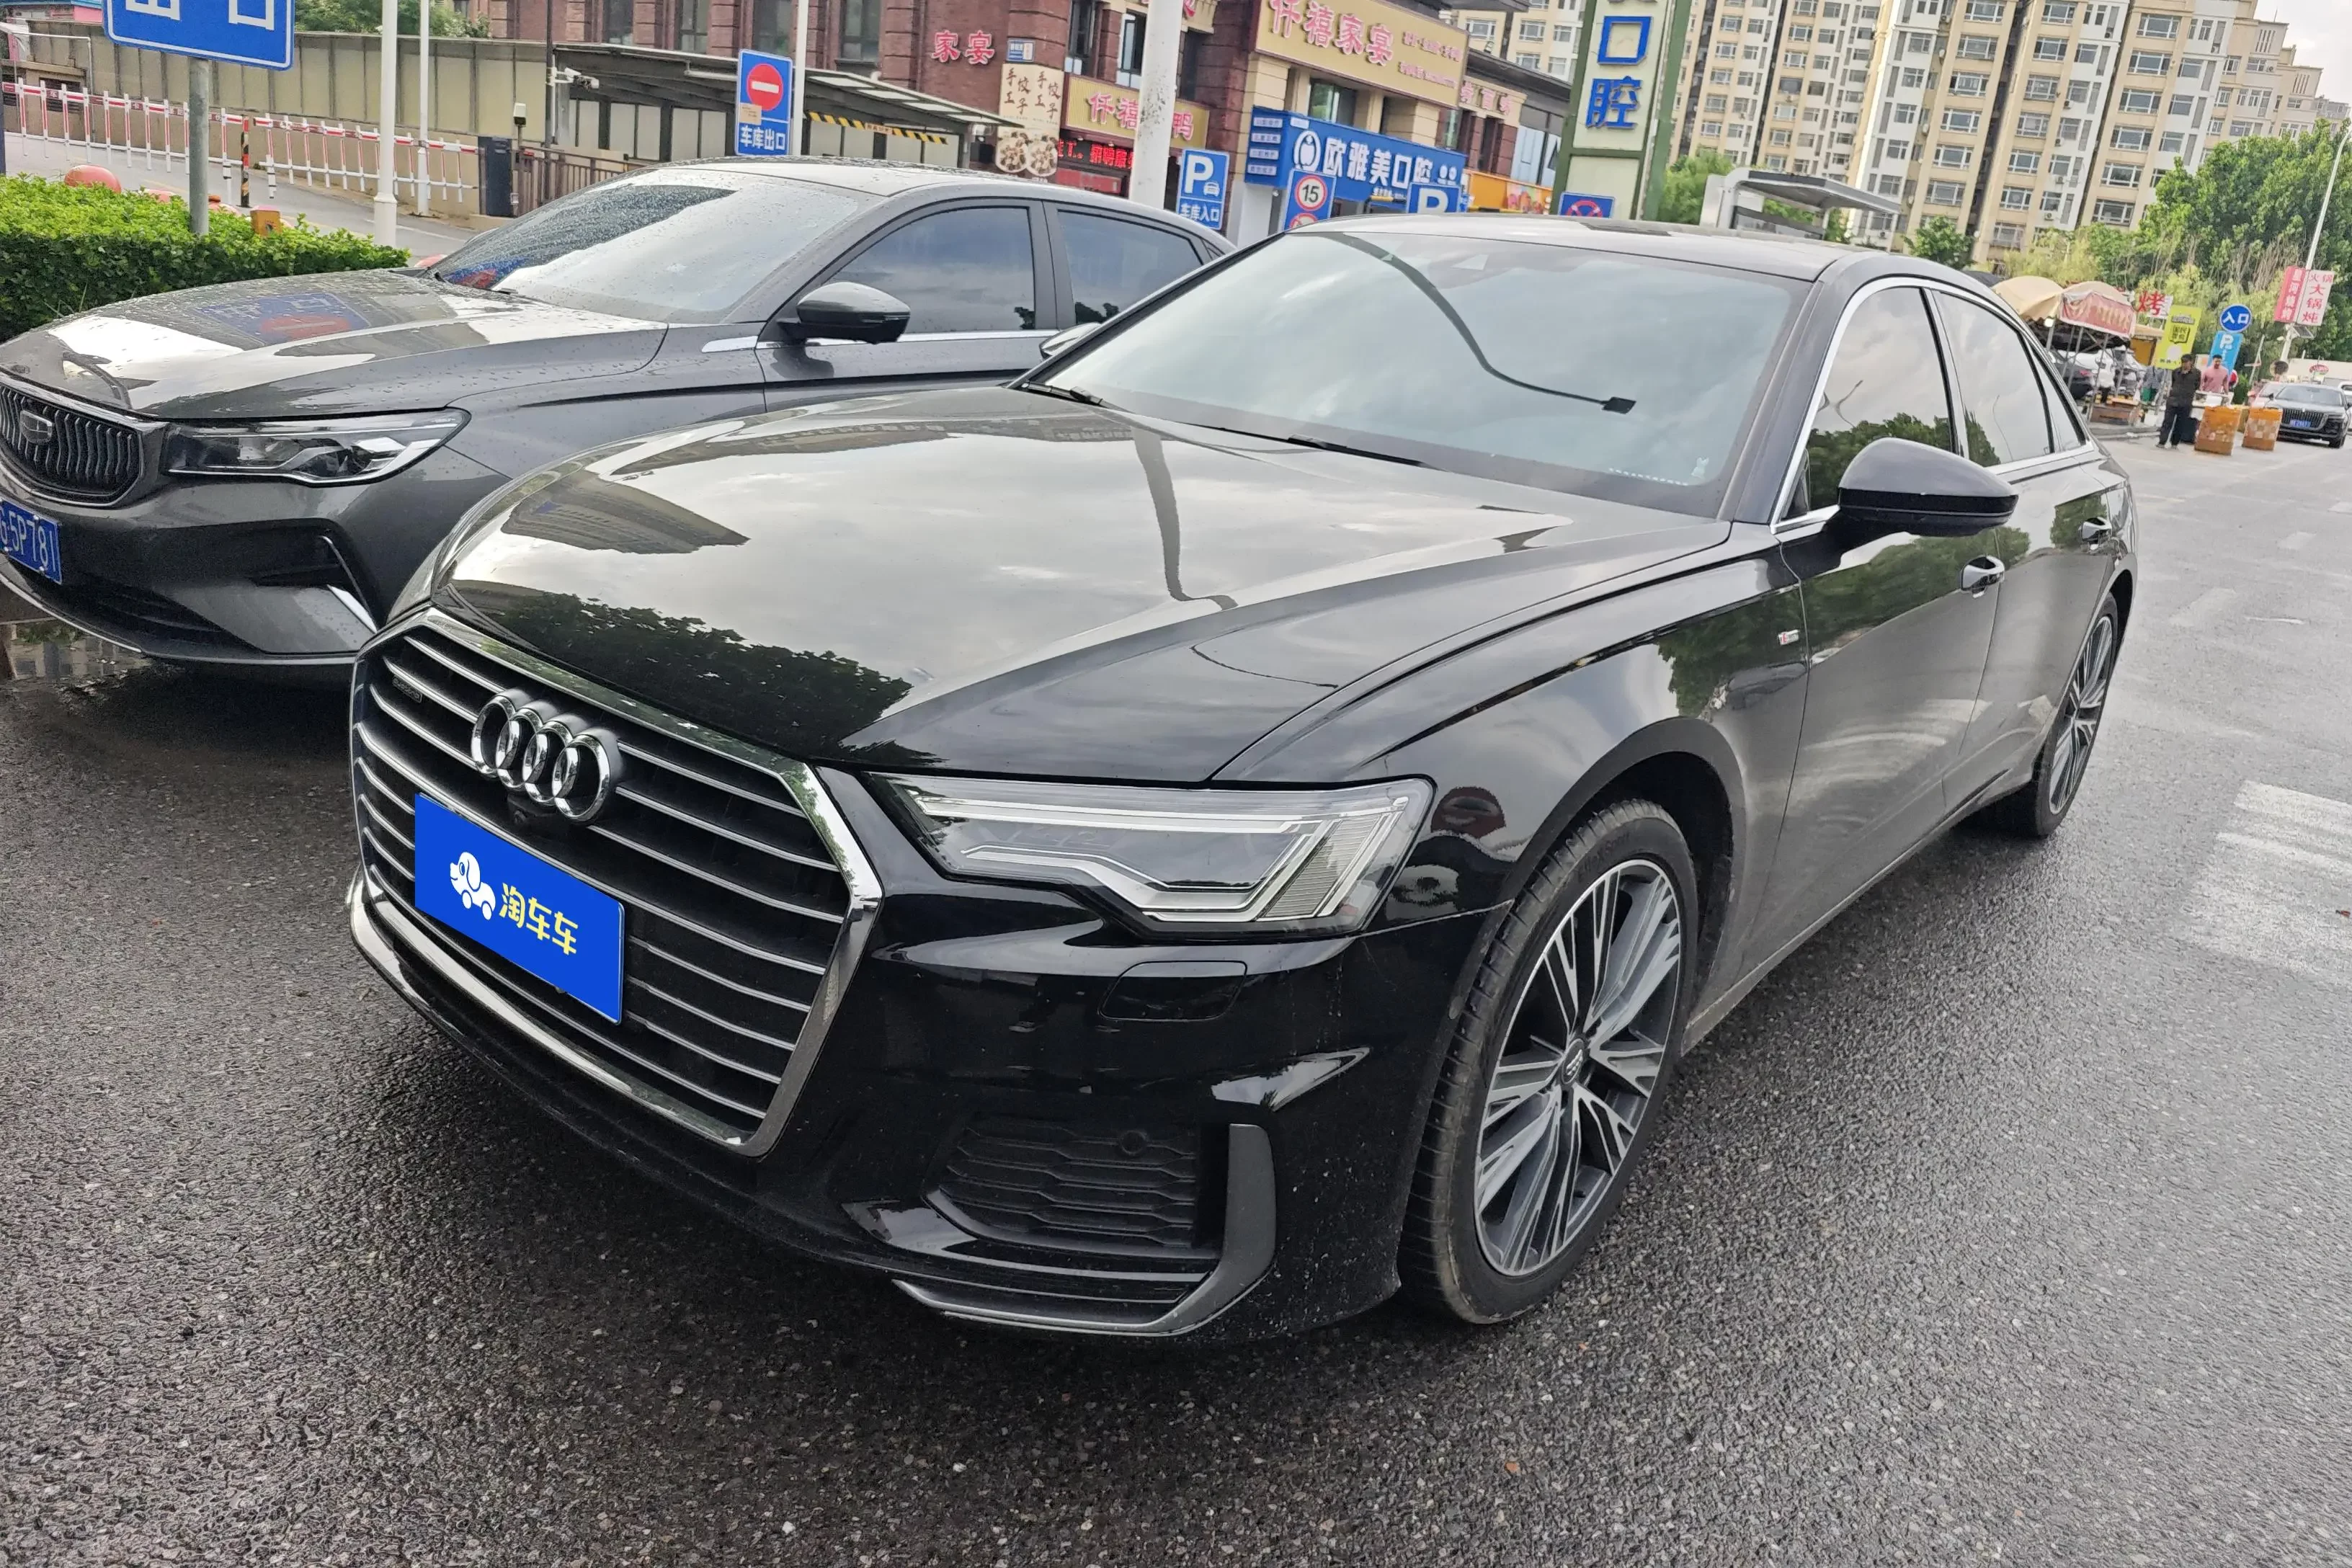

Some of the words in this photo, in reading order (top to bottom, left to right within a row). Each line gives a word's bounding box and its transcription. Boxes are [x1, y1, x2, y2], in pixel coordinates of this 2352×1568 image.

[931, 30, 994, 65] 家宴
[1269, 0, 1393, 66] 仟禧家宴
[1585, 16, 1652, 130] 口腔
[1089, 92, 1194, 142] 仟禧鸭
[739, 125, 786, 151] 车库出口
[1184, 154, 1214, 194] P
[1322, 136, 1434, 190] 欧雅美口腔
[1302, 184, 1320, 202] 15
[1417, 187, 1448, 214] P
[1180, 202, 1220, 223] 车库入口
[2222, 311, 2249, 324] 入口
